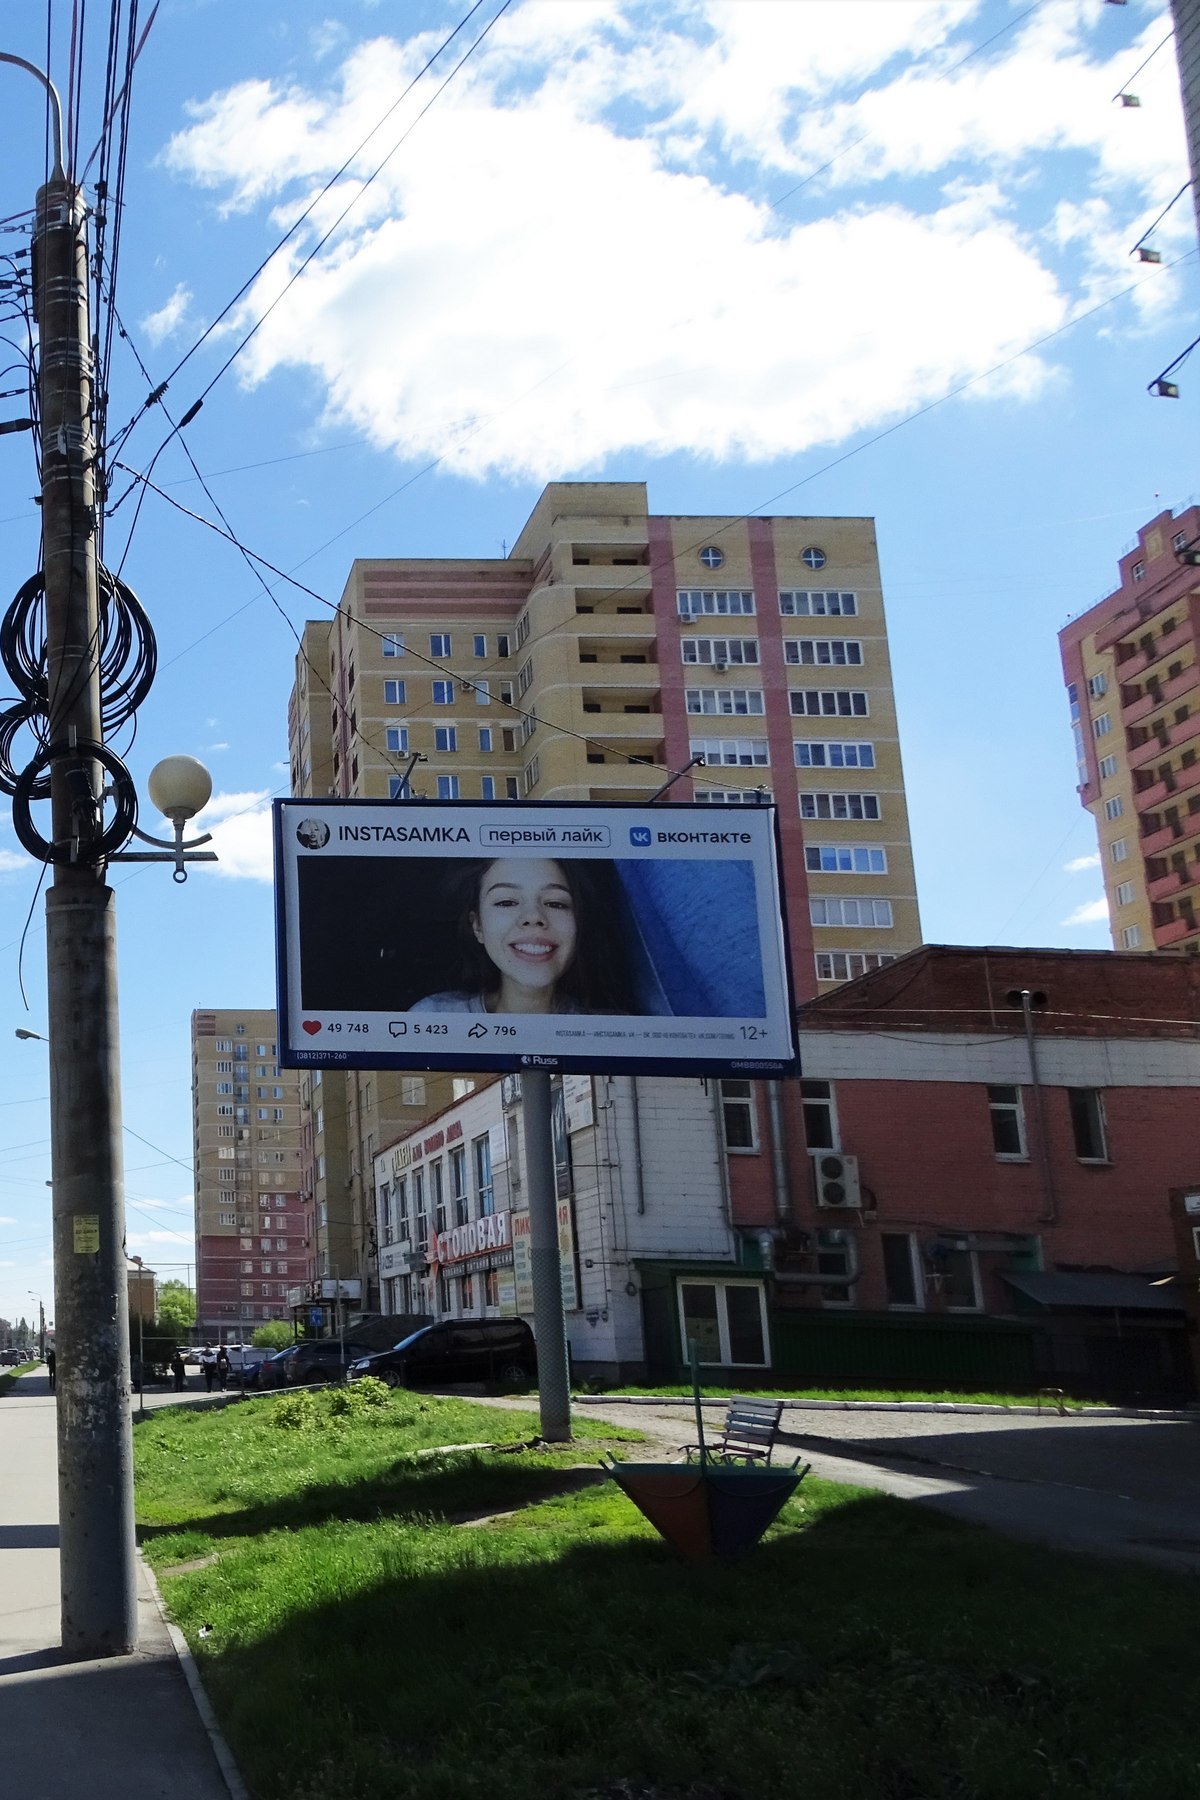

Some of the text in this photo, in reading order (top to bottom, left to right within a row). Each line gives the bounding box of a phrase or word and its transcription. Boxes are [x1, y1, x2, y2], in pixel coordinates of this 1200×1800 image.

[338, 825, 471, 842] INSTASAMKA
[489, 828, 604, 845] первый лайк
[657, 831, 752, 844] вконтакте
[327, 1023, 370, 1034] 49 748
[413, 1024, 449, 1036] 5 423
[493, 1025, 517, 1036] 796
[739, 1025, 768, 1040] 12+
[296, 1051, 348, 1060] (3812)371-260
[532, 1055, 558, 1066] Russ
[436, 1210, 511, 1264] СТОЛОВАЯ
